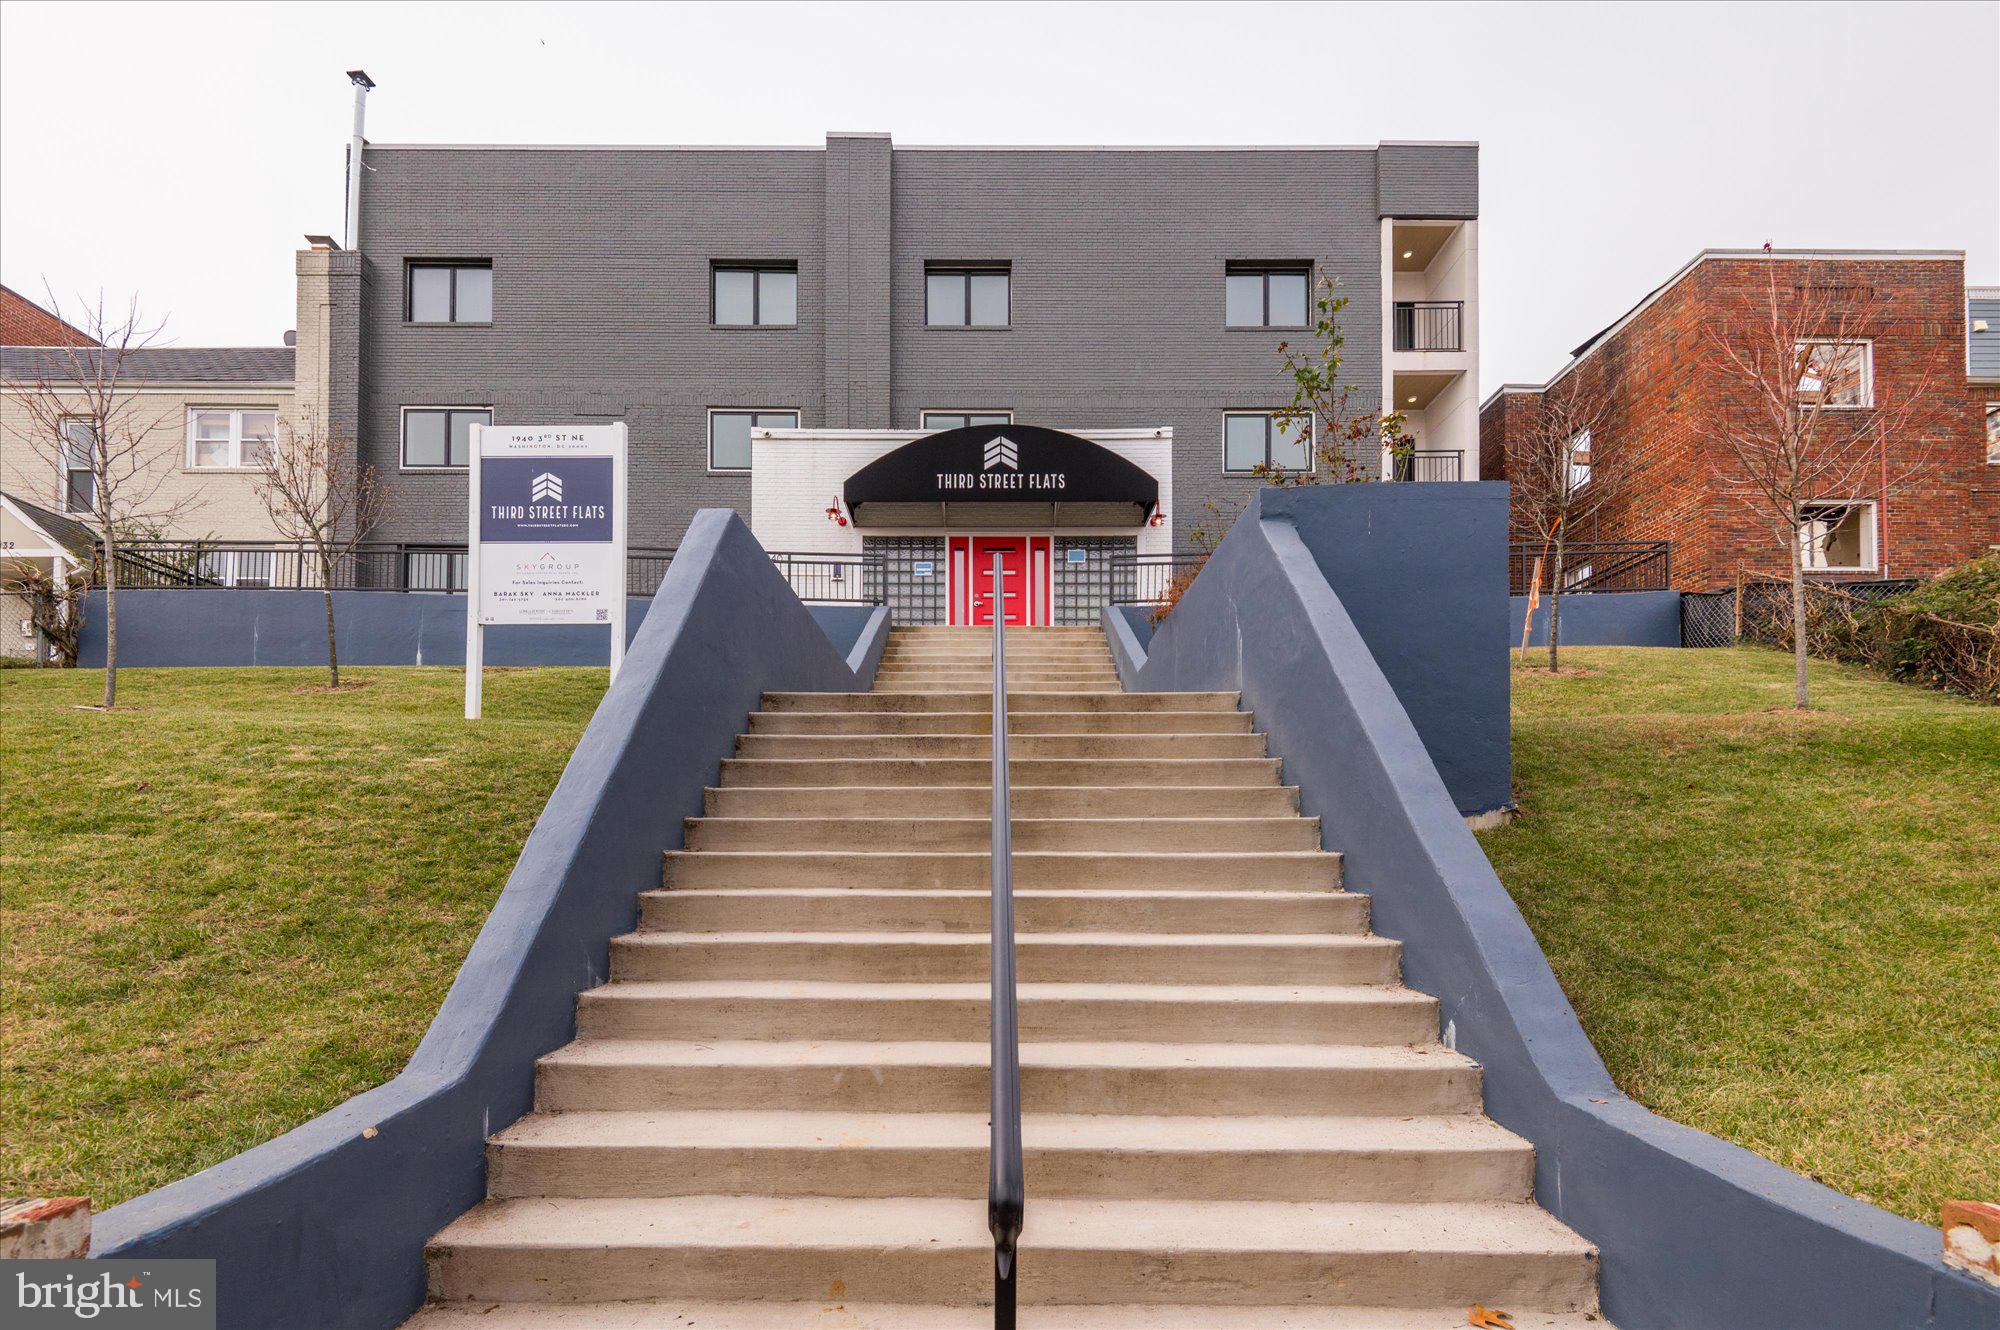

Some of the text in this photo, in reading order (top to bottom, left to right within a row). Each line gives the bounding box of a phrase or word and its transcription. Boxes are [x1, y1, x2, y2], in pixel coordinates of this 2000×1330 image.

[936, 474, 1066, 489] THIRD STREET FLATS
[491, 505, 605, 519] THIRD STREET FLATS
[0, 541, 15, 549] 32
